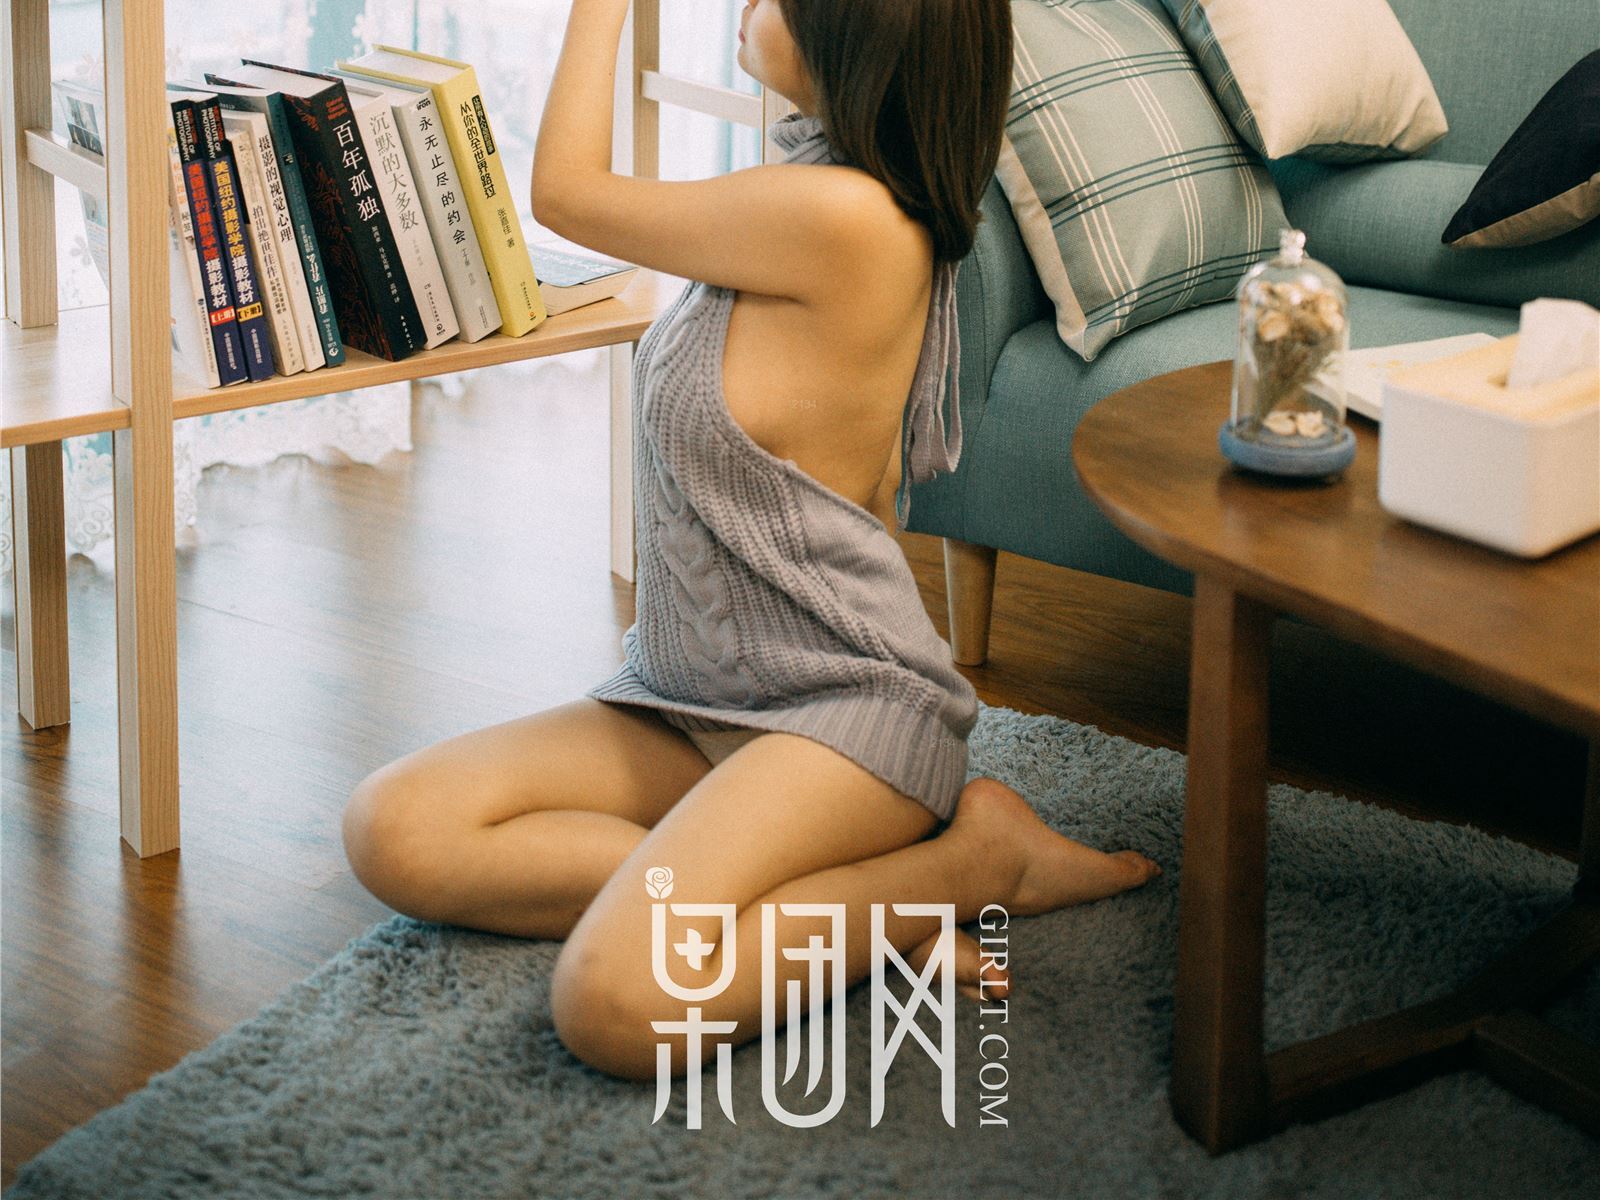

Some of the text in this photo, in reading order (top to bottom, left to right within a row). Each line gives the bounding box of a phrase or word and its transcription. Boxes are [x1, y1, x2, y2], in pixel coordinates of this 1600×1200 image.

[175, 111, 190, 161] PHOTOGRAPHY
[182, 109, 194, 143] INSTITUTE
[188, 144, 196, 154] OF
[201, 109, 216, 160] PHOTOGRAPHY
[207, 107, 222, 152] INSTITUTE OF
[333, 120, 381, 221] 百年孤独
[370, 111, 419, 232] 沉默的大多数
[460, 101, 496, 199] 从你的全世界路过
[257, 137, 293, 242] 摄影的视觉心理
[420, 117, 466, 244] 永无止尽的约会
[253, 205, 276, 278] 拍出绝世佳作
